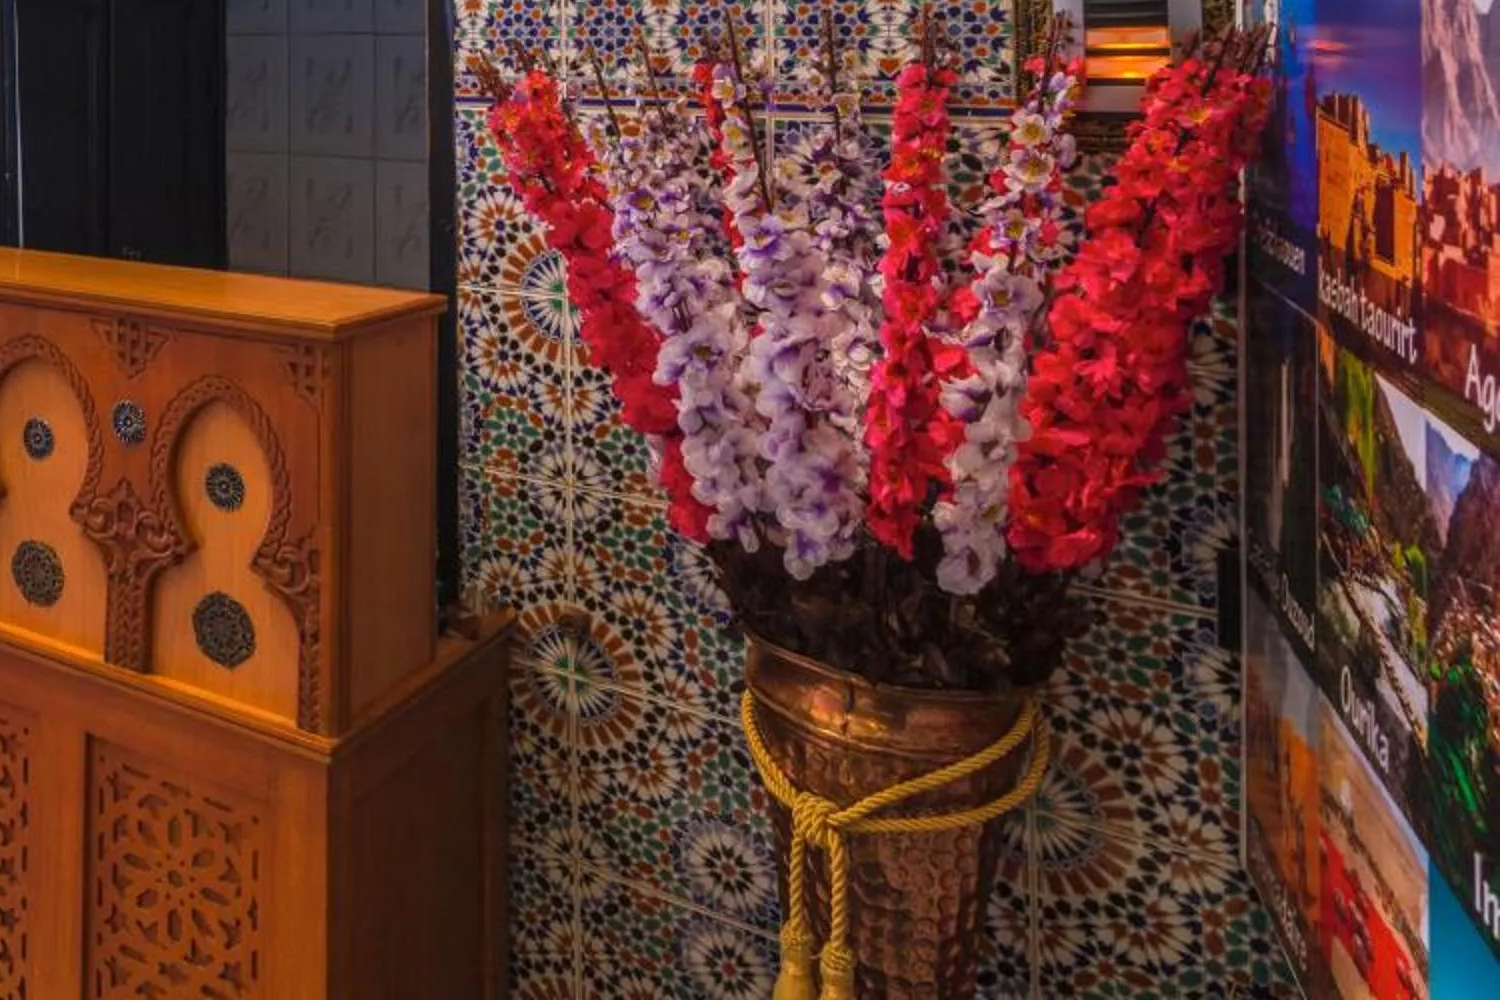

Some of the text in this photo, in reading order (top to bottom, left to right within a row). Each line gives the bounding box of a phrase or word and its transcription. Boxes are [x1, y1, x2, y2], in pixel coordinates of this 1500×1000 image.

[1361, 287, 1418, 365] taourirt
[1464, 343, 1500, 435] Ag
[1340, 664, 1390, 775] Ourika
